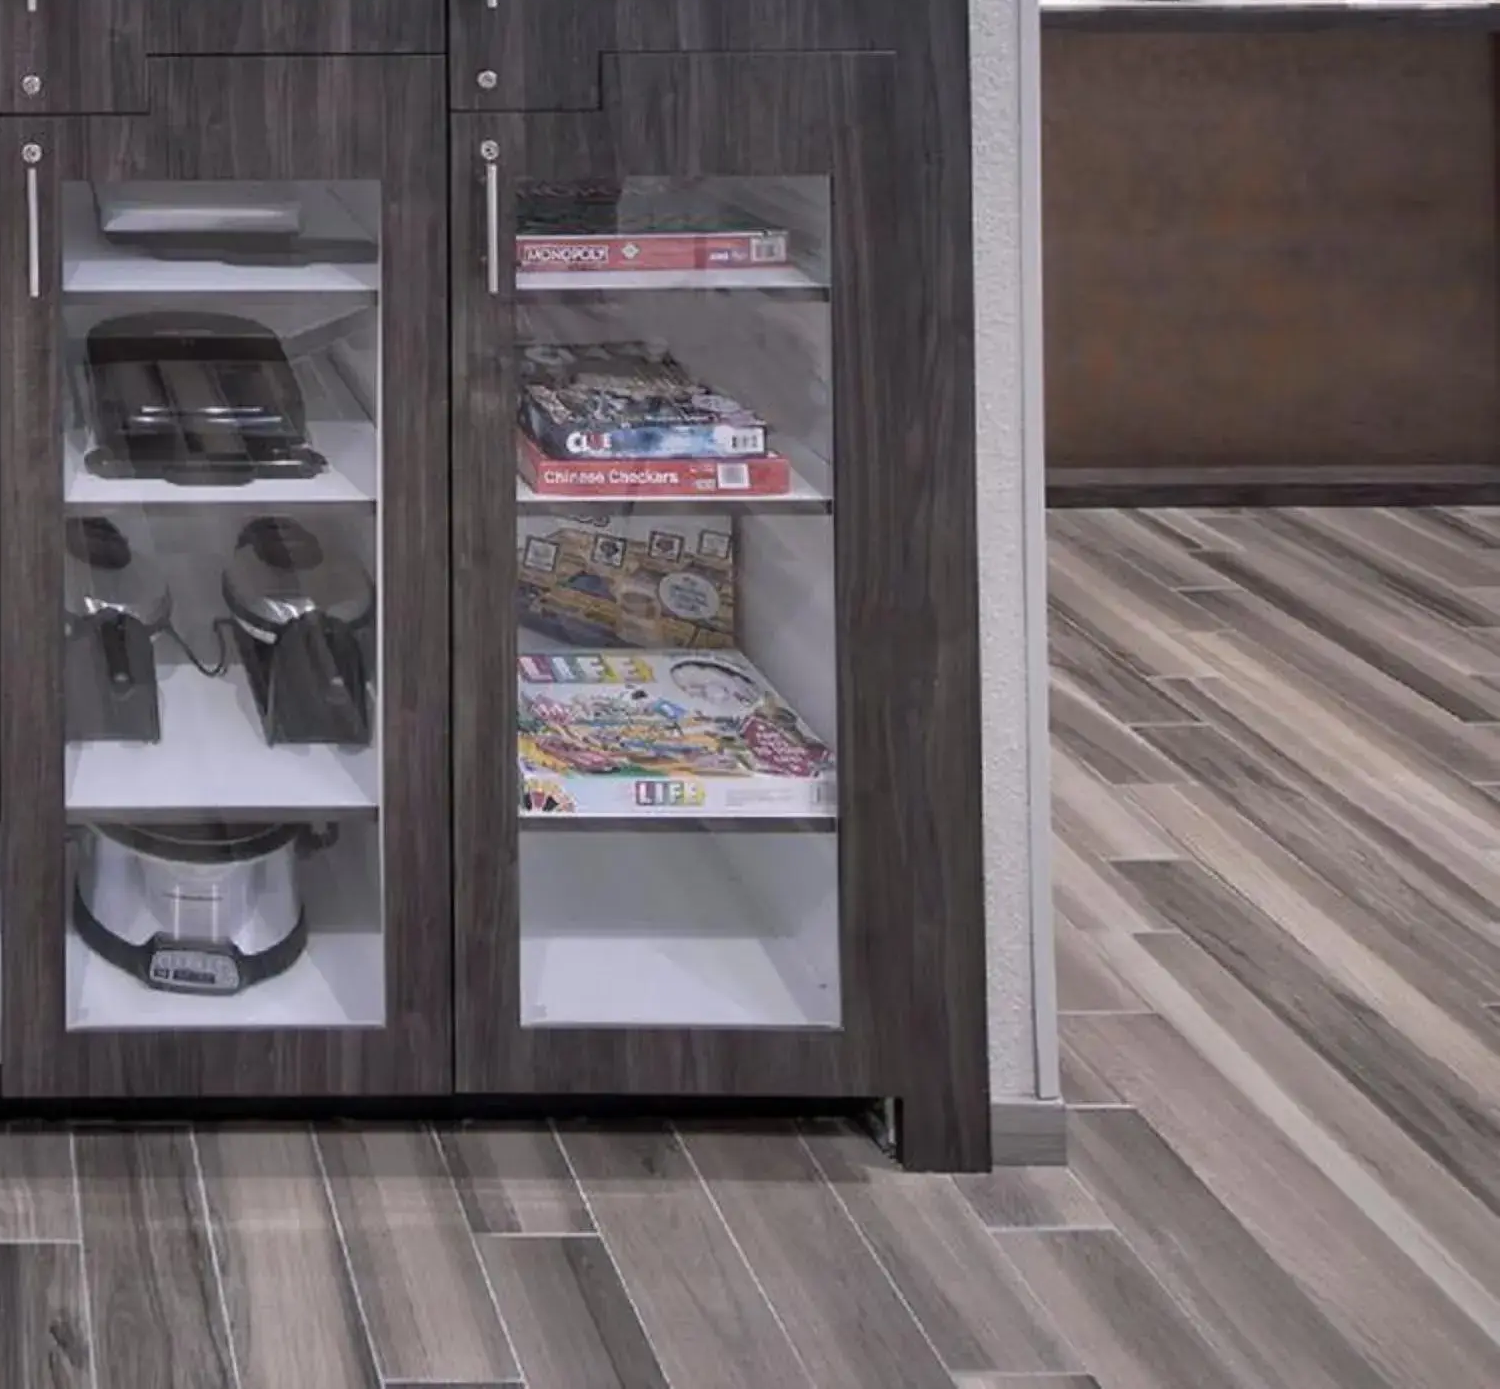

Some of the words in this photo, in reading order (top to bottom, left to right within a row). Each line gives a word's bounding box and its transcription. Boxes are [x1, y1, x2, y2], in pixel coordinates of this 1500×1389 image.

[526, 246, 606, 262] MONOPOLY
[543, 470, 604, 485] Chinese
[608, 470, 680, 485] Checkers
[637, 781, 702, 805] LIFE
